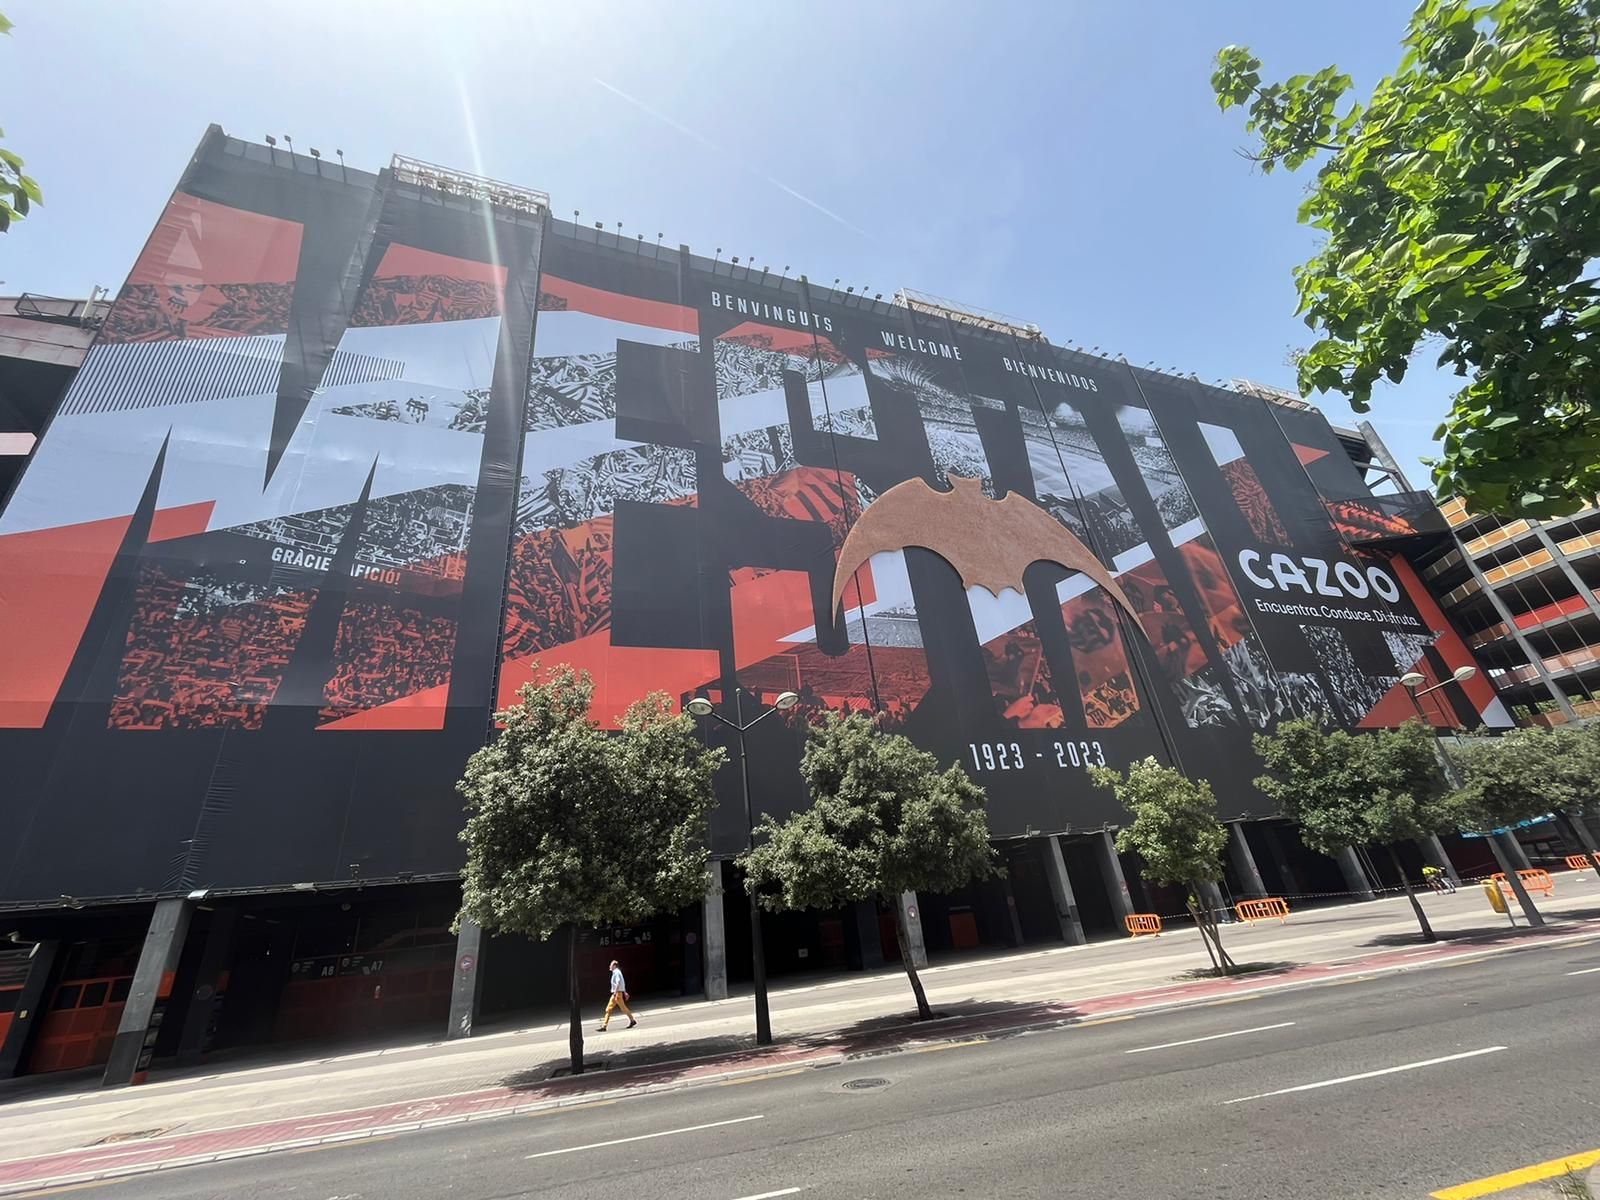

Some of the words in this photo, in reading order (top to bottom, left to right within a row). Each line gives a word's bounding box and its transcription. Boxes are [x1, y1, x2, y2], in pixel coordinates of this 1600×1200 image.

[711, 290, 833, 332] BENVINGUTS
[881, 330, 963, 361] WELCOME
[1003, 356, 1098, 392] BIENVENIDOS
[271, 546, 332, 571] GRÀCIE
[1238, 549, 1400, 603] CAZOO
[1255, 598, 1322, 617] Encuentra.
[1321, 605, 1375, 622] Conduce.
[969, 743, 1024, 771] 1923
[1053, 741, 1106, 767] 2023
[320, 965, 335, 976] A8
[370, 960, 383, 971] A7
